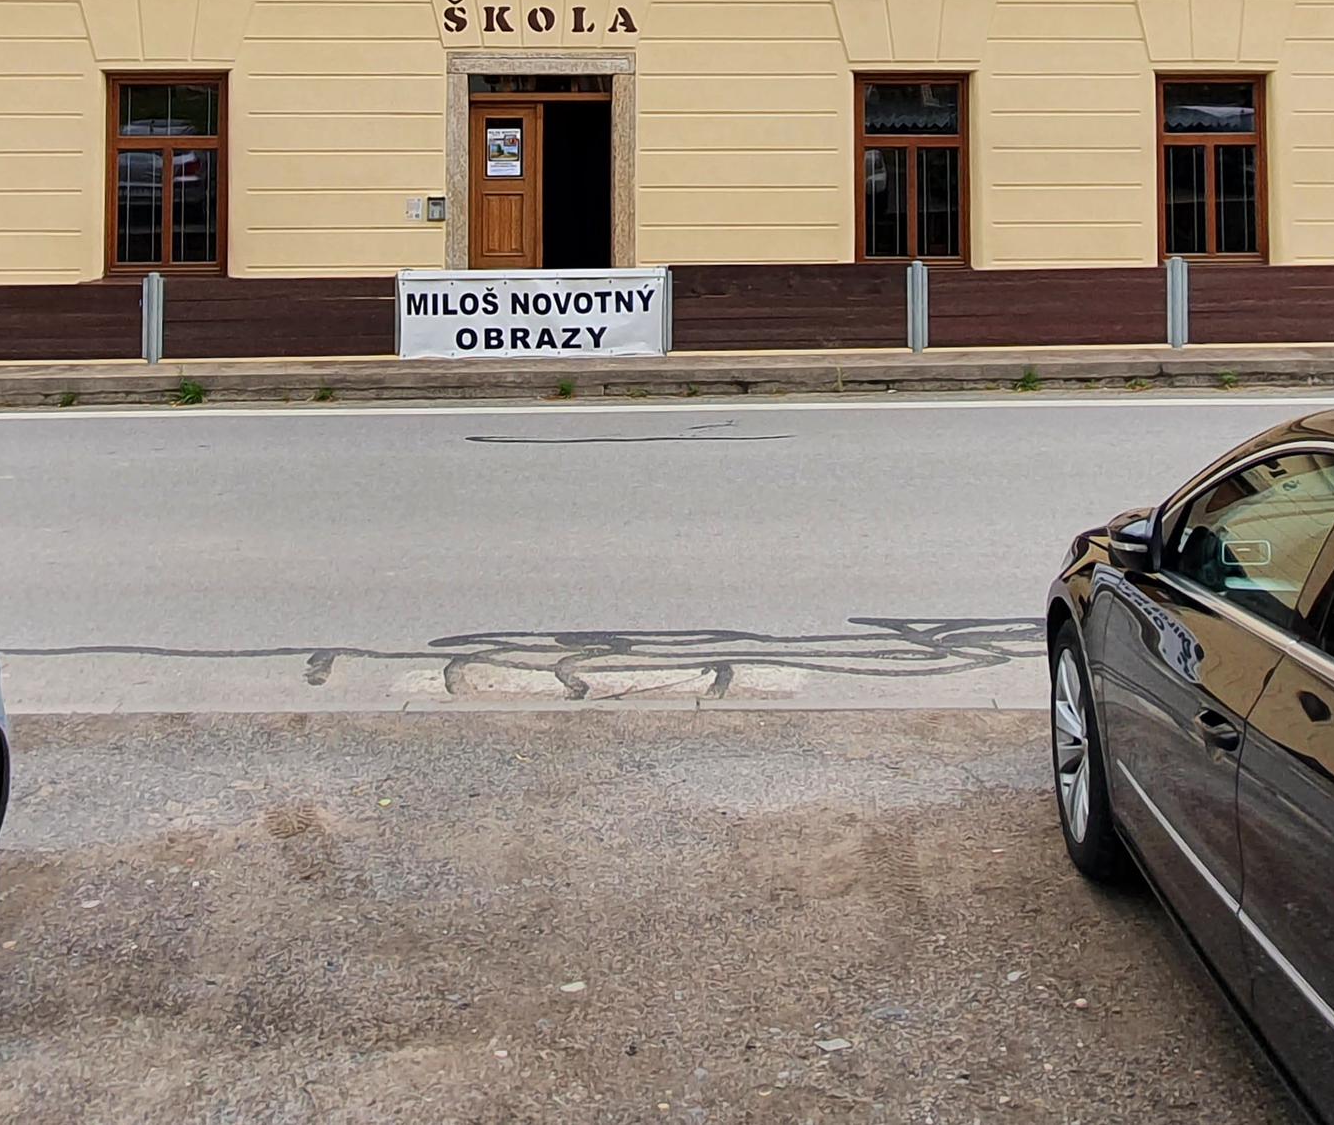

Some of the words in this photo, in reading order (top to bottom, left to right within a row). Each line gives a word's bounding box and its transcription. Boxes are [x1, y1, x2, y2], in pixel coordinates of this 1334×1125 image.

[406, 287, 499, 316] MILOŠ
[511, 284, 656, 315] NOVOTNÝ
[455, 325, 607, 350] OBRAZY
